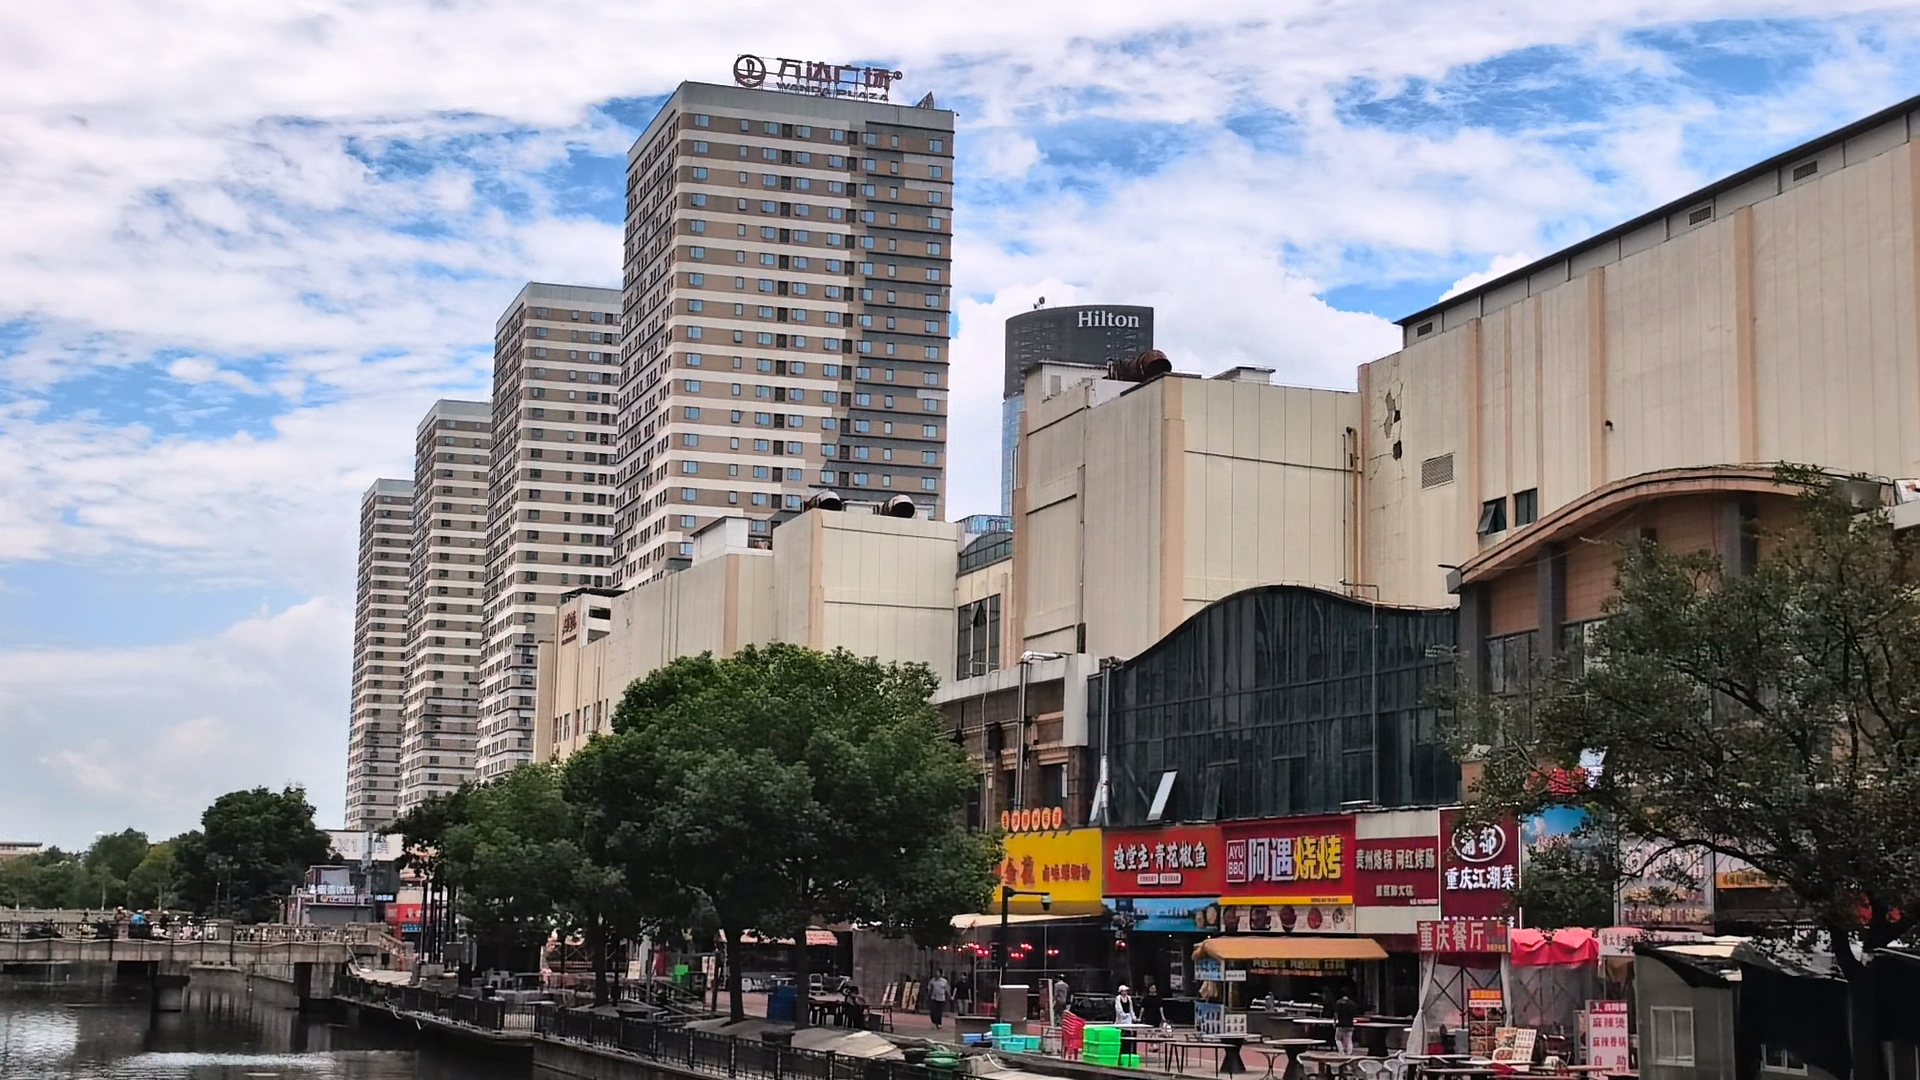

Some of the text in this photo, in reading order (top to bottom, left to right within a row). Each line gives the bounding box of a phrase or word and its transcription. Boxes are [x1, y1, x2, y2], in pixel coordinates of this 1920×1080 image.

[776, 57, 890, 91] 万达广场
[776, 82, 890, 102] WANDA PLAZA
[1077, 310, 1140, 328] Hilton
[1228, 845, 1244, 859] AYU
[1248, 834, 1344, 882] 阿遇烧烤
[1395, 847, 1435, 870] 网红烤肠
[1228, 861, 1245, 875] BBQ
[1444, 865, 1516, 891] 重庆江湖菜
[1419, 921, 1484, 952] 重庆餐厅
[1592, 1016, 1626, 1029] 麻辣烫
